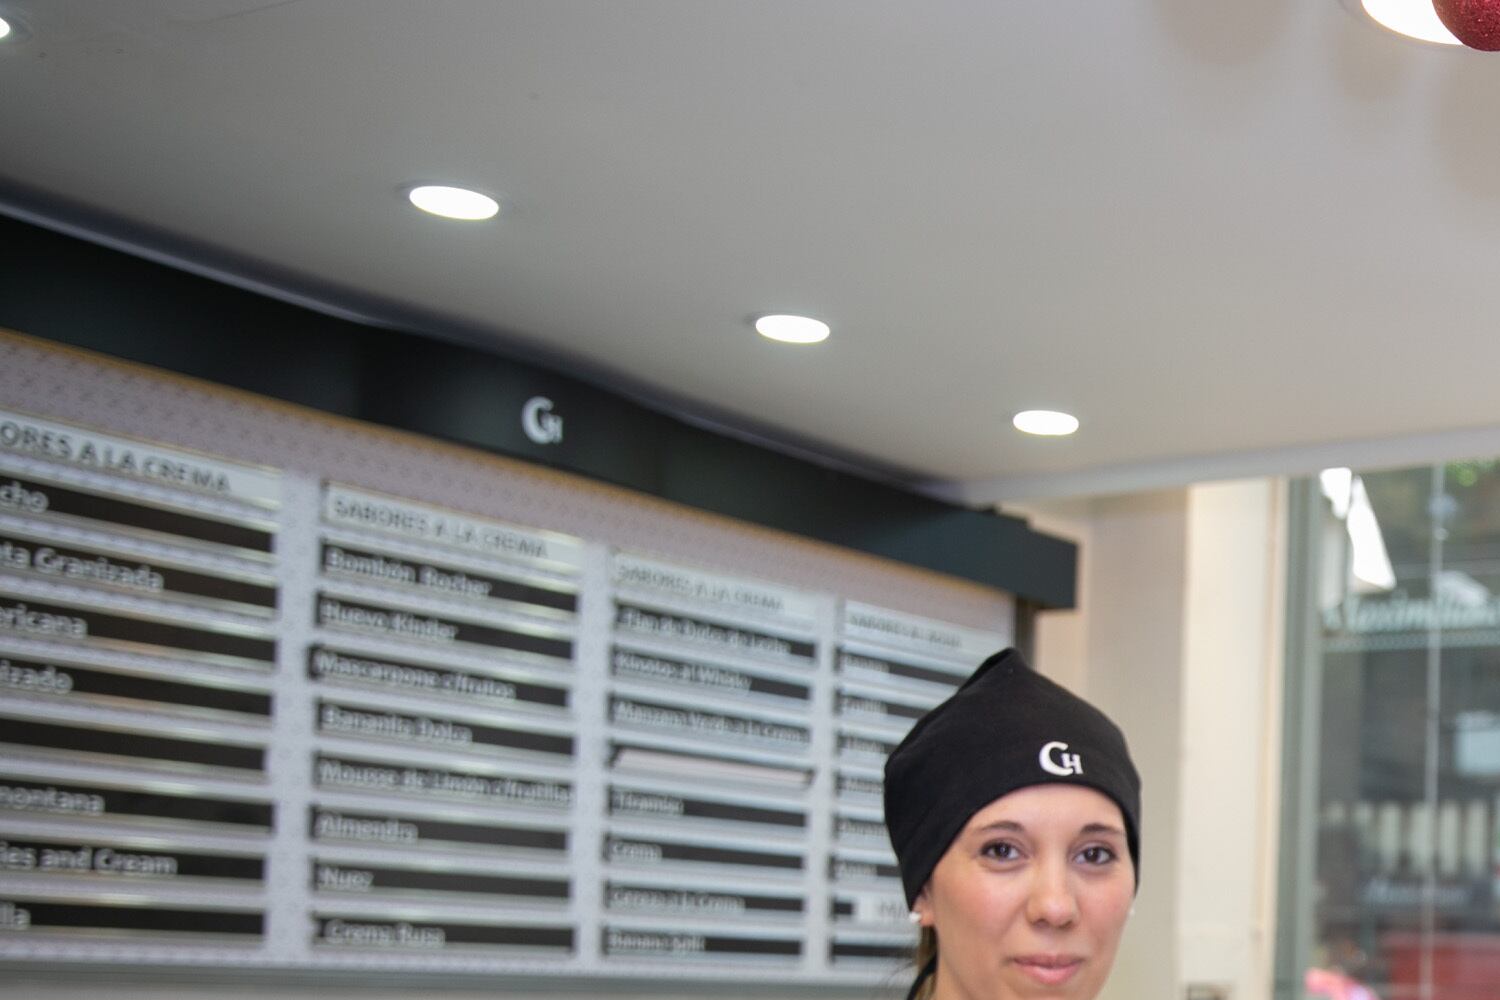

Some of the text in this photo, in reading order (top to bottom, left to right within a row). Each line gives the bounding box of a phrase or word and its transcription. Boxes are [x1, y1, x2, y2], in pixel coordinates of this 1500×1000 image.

[78, 441, 99, 463] A
[103, 447, 137, 472] LA
[142, 456, 232, 492] CREMA
[34, 547, 164, 592] Granizada
[40, 845, 92, 873] and
[94, 848, 178, 876] Cream
